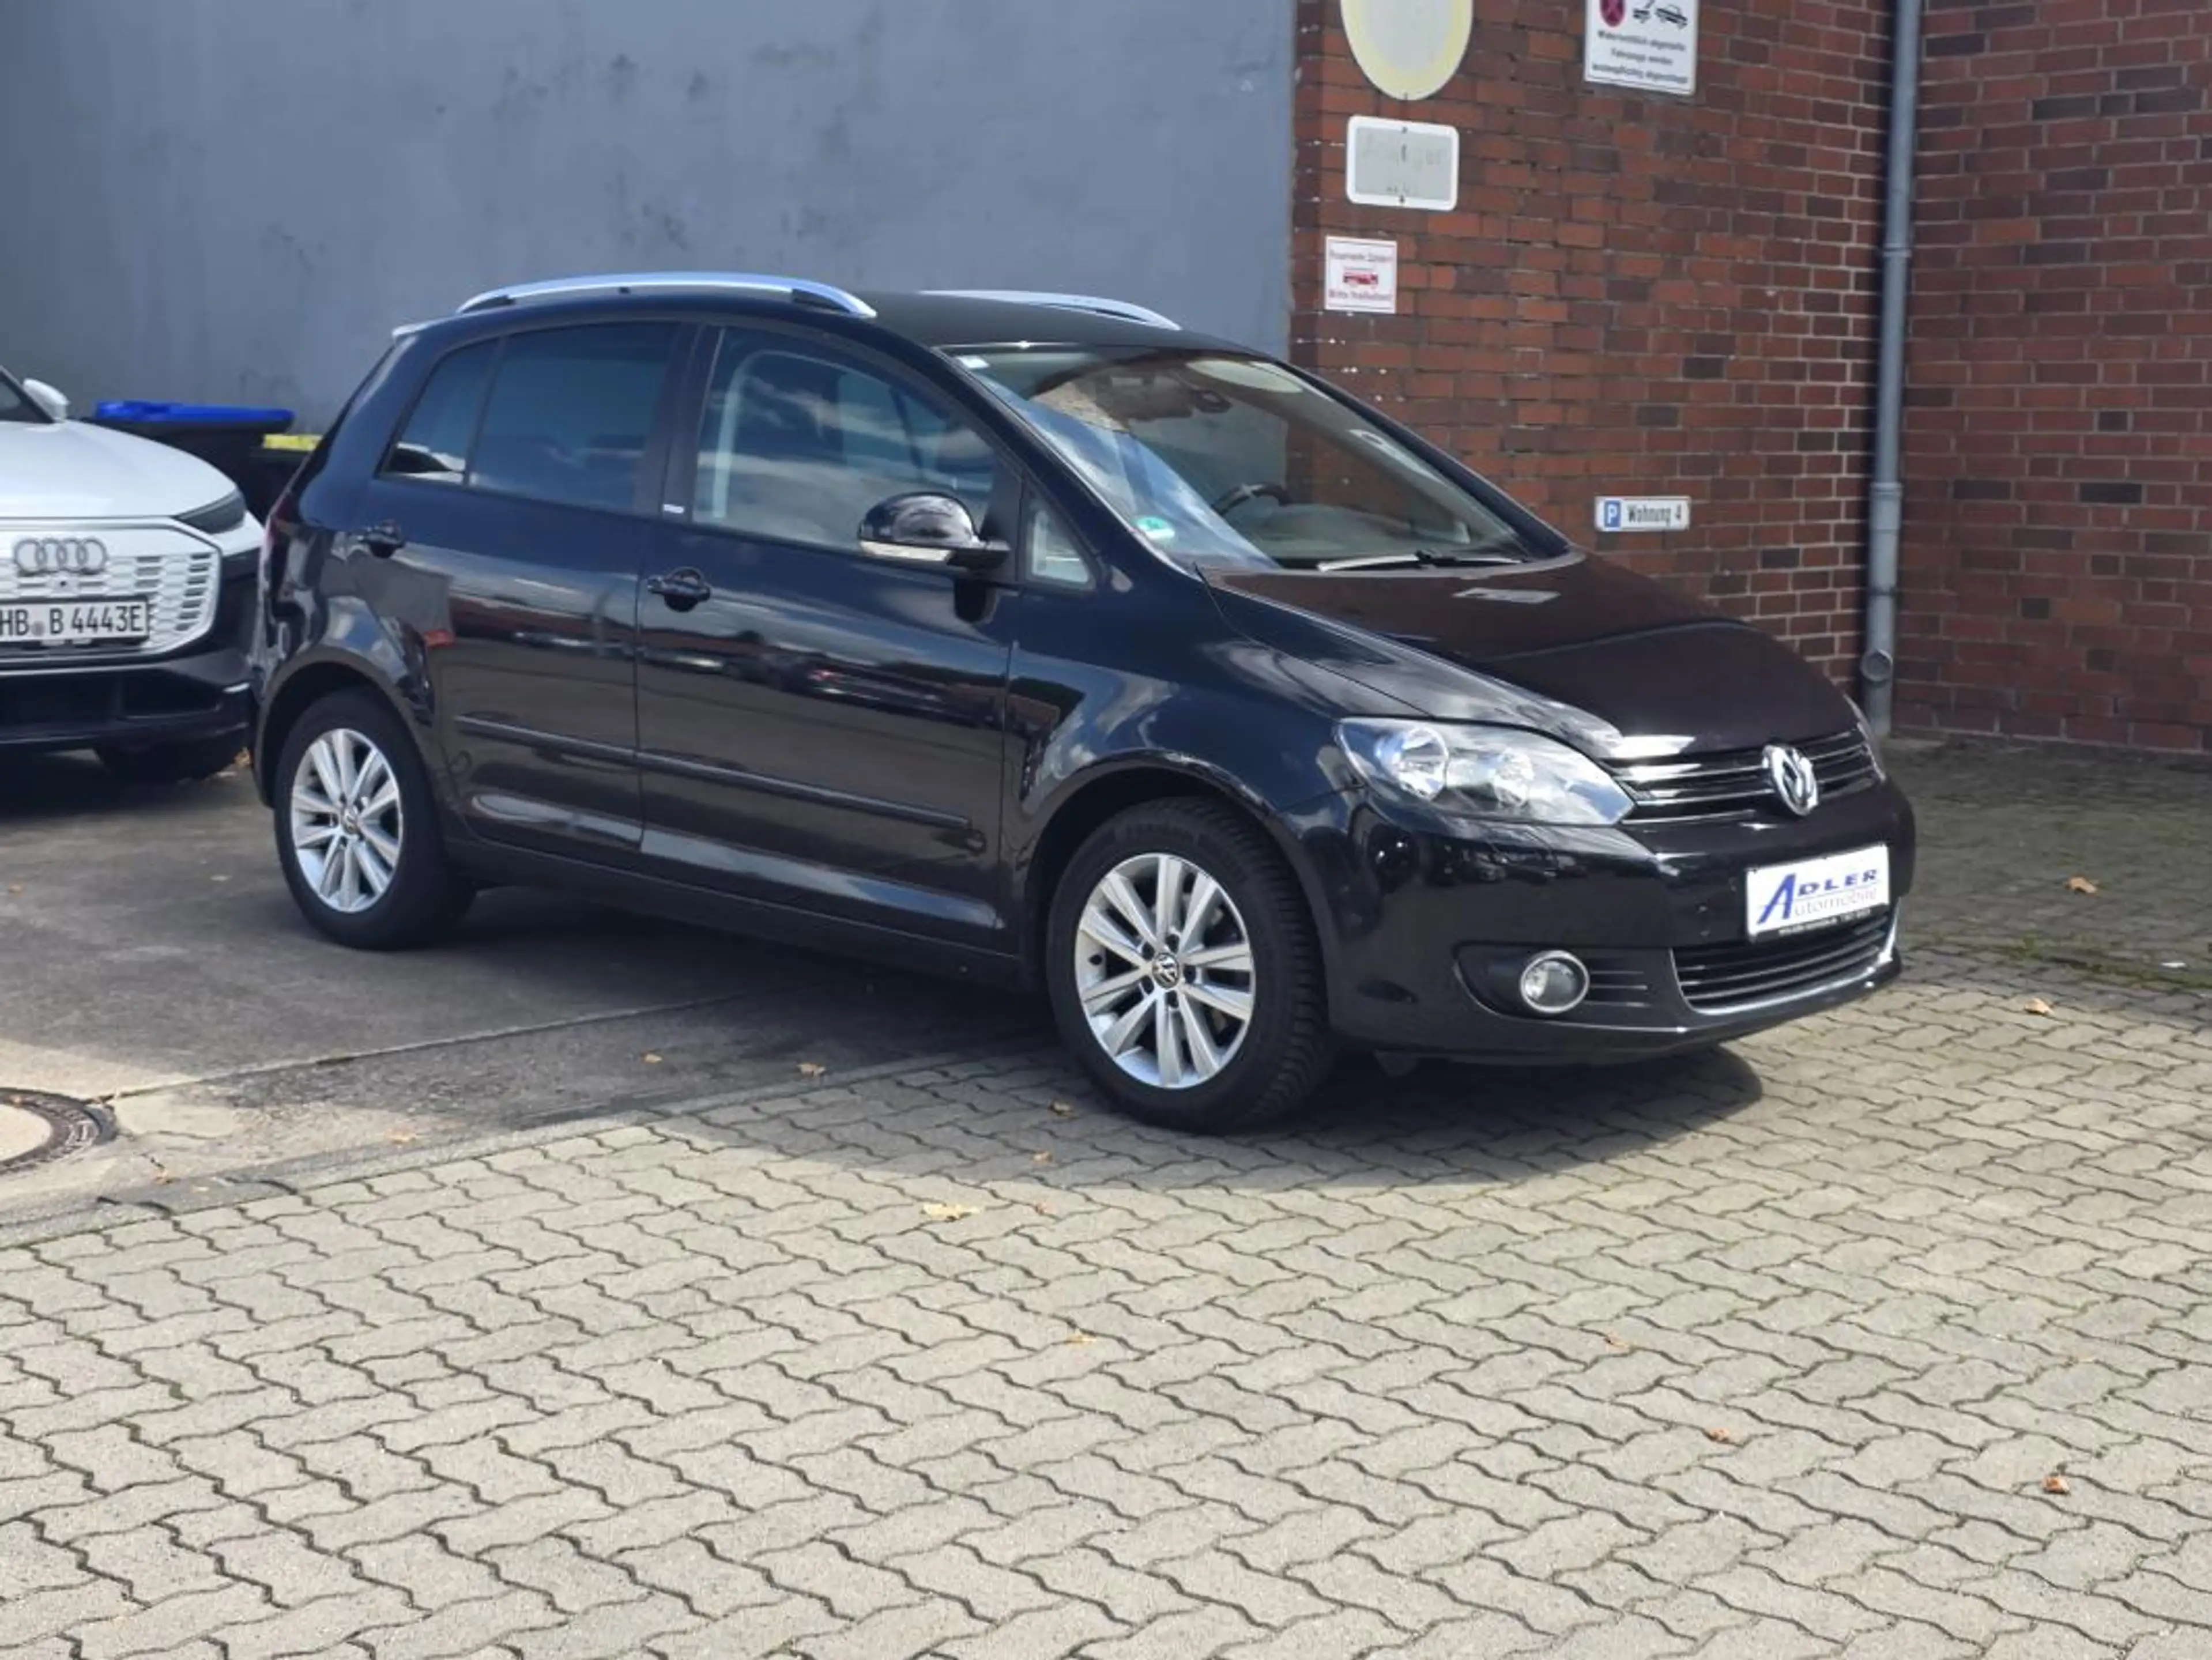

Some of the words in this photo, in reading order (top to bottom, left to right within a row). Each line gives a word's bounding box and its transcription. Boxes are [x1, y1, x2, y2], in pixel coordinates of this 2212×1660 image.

[0, 609, 29, 636] HB
[49, 608, 64, 635] B
[71, 605, 144, 633] 4443E
[1757, 869, 1878, 925] ADLER
